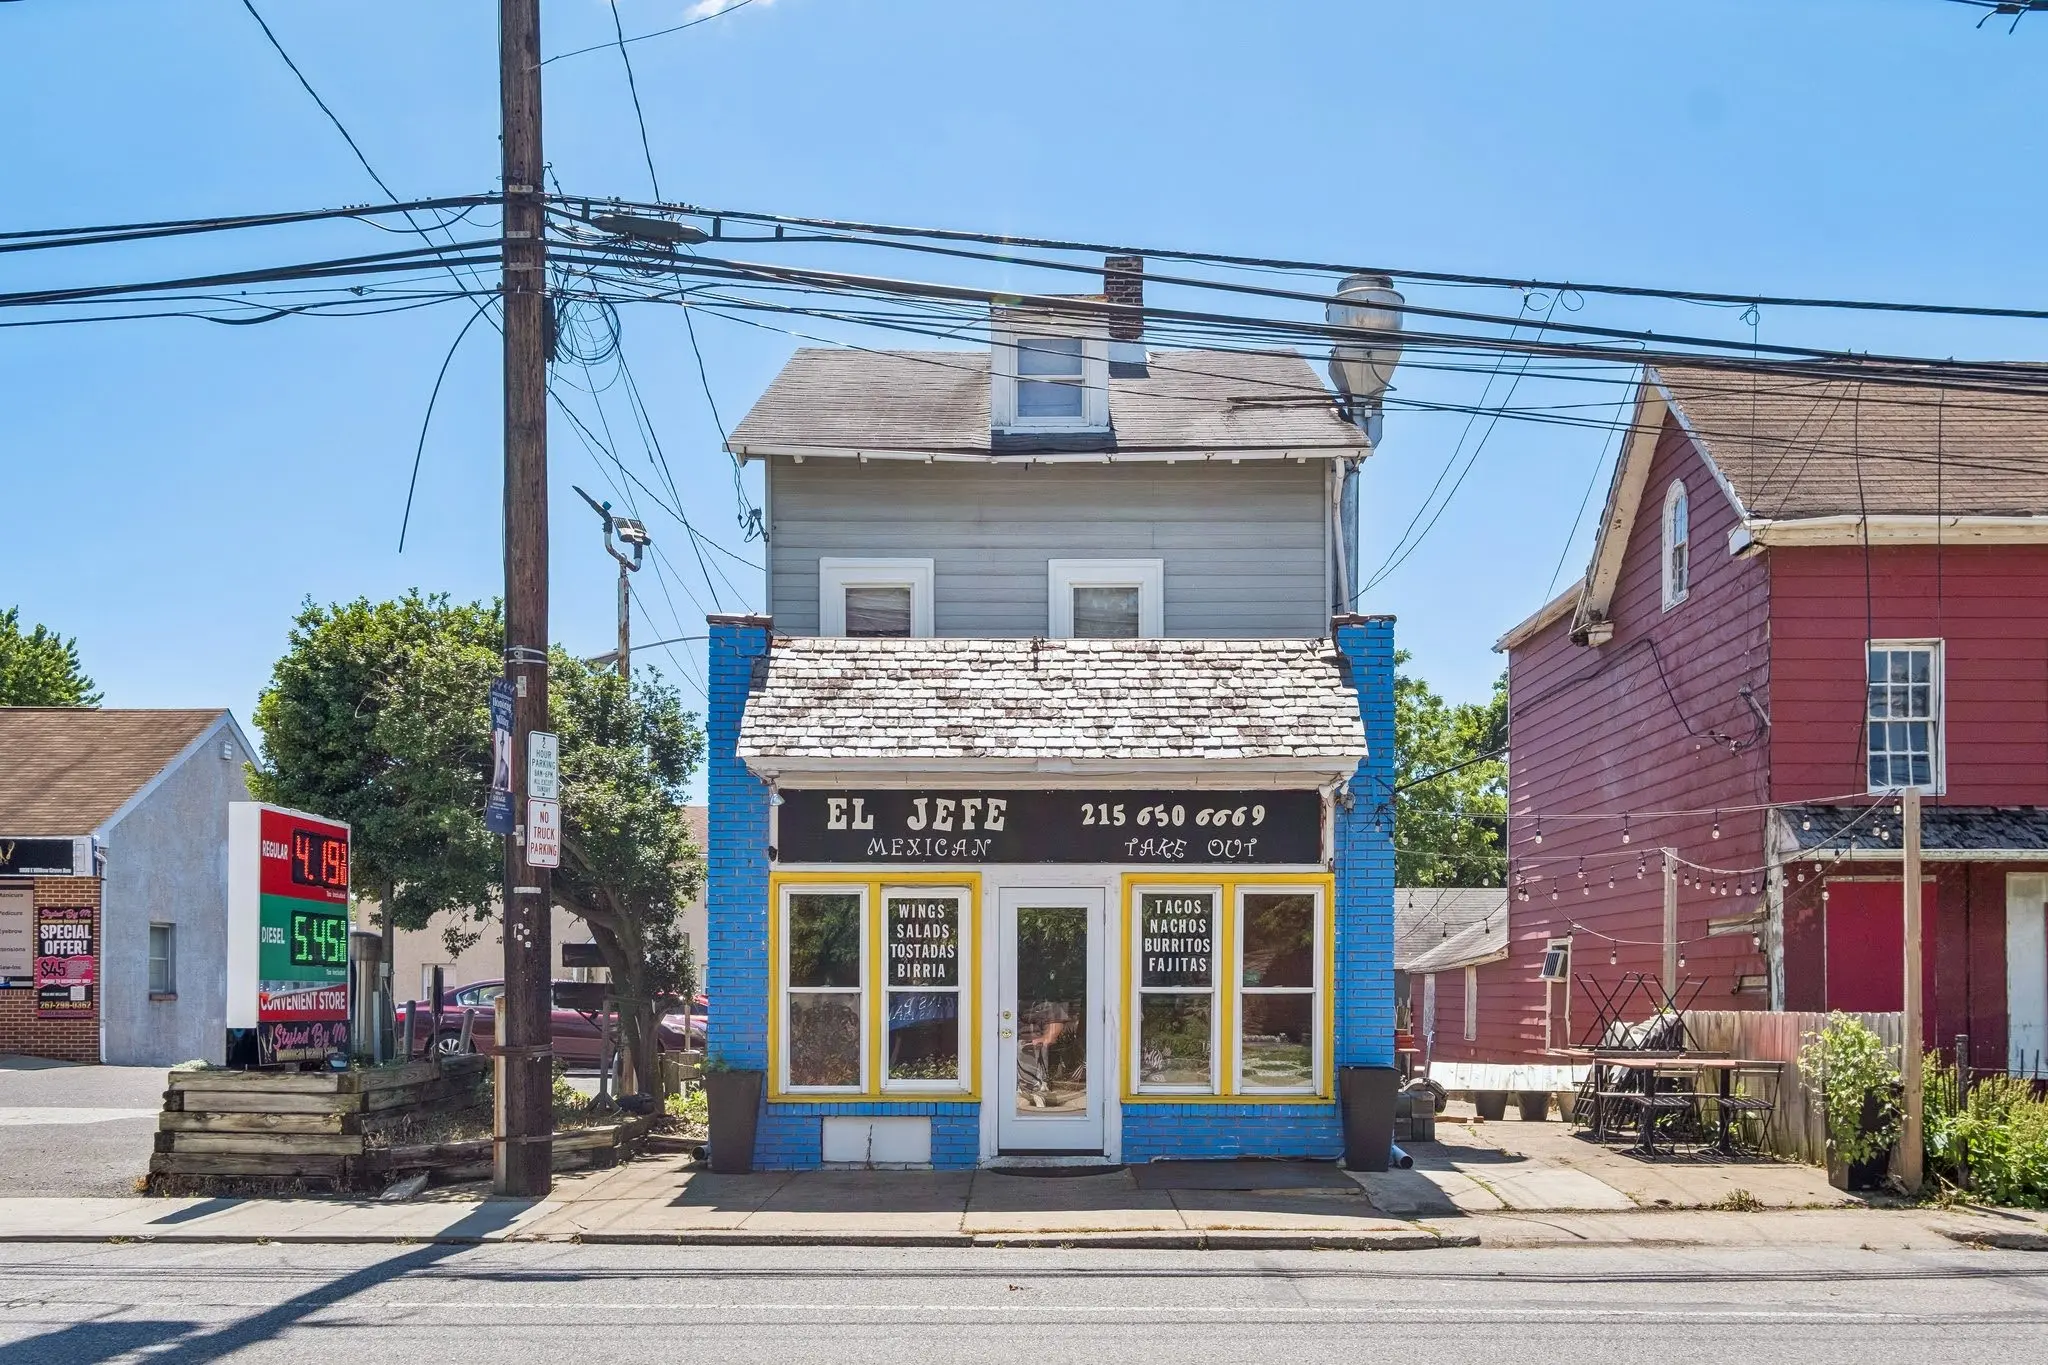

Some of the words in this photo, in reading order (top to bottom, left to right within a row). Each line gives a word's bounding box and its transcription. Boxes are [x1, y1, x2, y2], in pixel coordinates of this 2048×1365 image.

[536, 750, 552, 759] HOUR
[532, 759, 556, 770] PARKING
[539, 811, 549, 824] NO
[827, 798, 874, 830] EL
[906, 797, 1007, 831] JEFE
[1081, 803, 1126, 826] 215
[1136, 804, 1185, 827] 650
[1195, 804, 1266, 827] 6669
[534, 826, 555, 841] TRUCK
[262, 839, 288, 860] REGULAR
[530, 842, 557, 857] PARKING
[867, 837, 991, 856] MEXICAN
[1124, 837, 1187, 858] TAKE
[1207, 837, 1257, 858] OUT
[899, 904, 945, 918] WINGS
[1155, 900, 1201, 914] TACOS
[40, 925, 92, 939] SPECIAL
[896, 924, 950, 938] SALADS
[1150, 919, 1206, 933] NACHOS
[261, 926, 285, 944] DIESEL
[45, 940, 87, 954] OFFER!
[890, 944, 955, 958] TOSTADAS
[1144, 938, 1210, 953] BURRITOS
[41, 960, 66, 978] $45
[897, 964, 946, 978] BIRRIA
[1149, 957, 1207, 972] FAJITAS
[319, 991, 346, 1010] STORE
[273, 1023, 309, 1052] Styled
[311, 1023, 330, 1050] By
[333, 1023, 347, 1043] M
